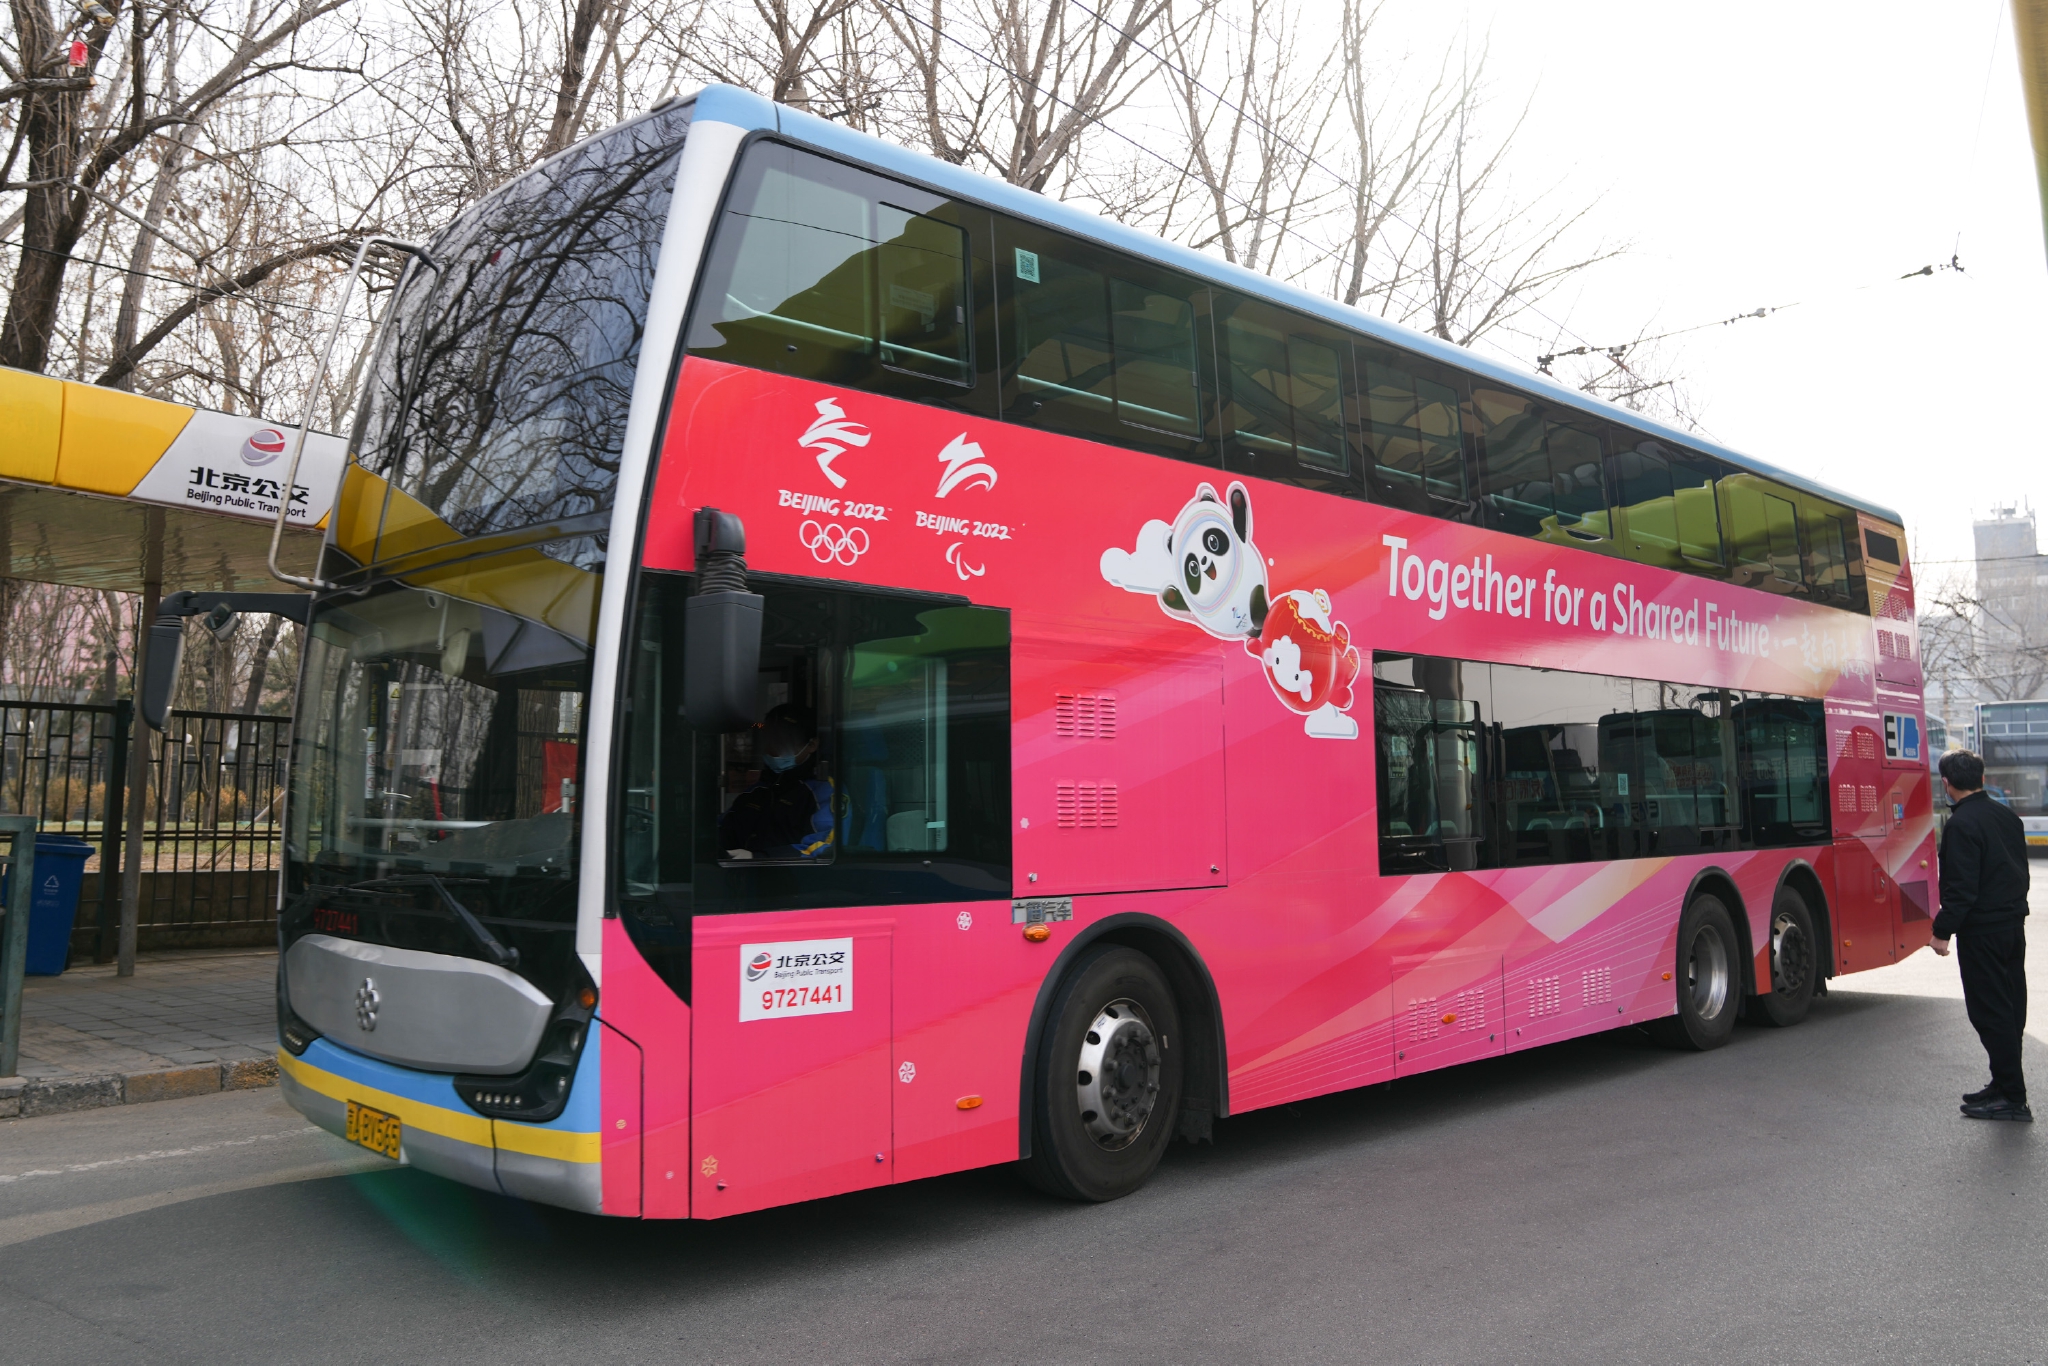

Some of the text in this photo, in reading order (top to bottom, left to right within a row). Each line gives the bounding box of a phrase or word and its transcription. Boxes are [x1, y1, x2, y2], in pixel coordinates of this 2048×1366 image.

[186, 488, 223, 505] Beijing
[224, 494, 256, 510] Public
[188, 466, 310, 505] 北京公交
[778, 489, 890, 522] BEIJING 2022
[915, 510, 1013, 541] BEIJING 2022
[1382, 533, 1770, 659] Together for a Shared Future
[774, 967, 844, 979] Beijing Public Transport
[775, 951, 846, 969] 北京公交
[762, 984, 842, 1011] 9727441
